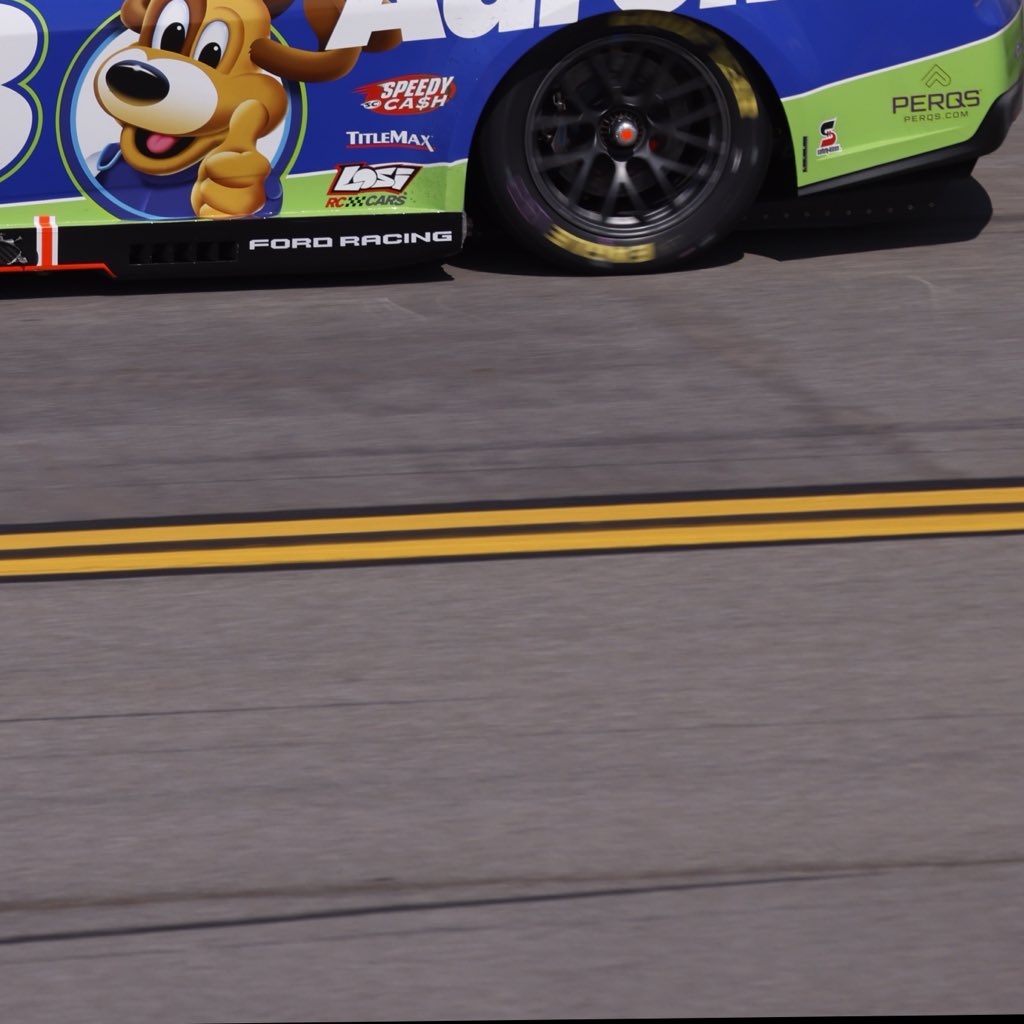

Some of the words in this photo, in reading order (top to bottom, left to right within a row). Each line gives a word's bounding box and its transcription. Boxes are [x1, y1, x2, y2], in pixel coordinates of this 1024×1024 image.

[380, 76, 454, 98] SPEEDY
[892, 90, 980, 114] PERQS
[904, 110, 969, 123] PERQS.COM
[325, 197, 346, 208] RC
[365, 194, 406, 206] CARS
[249, 236, 333, 251] FORD
[340, 230, 453, 247] RACING
